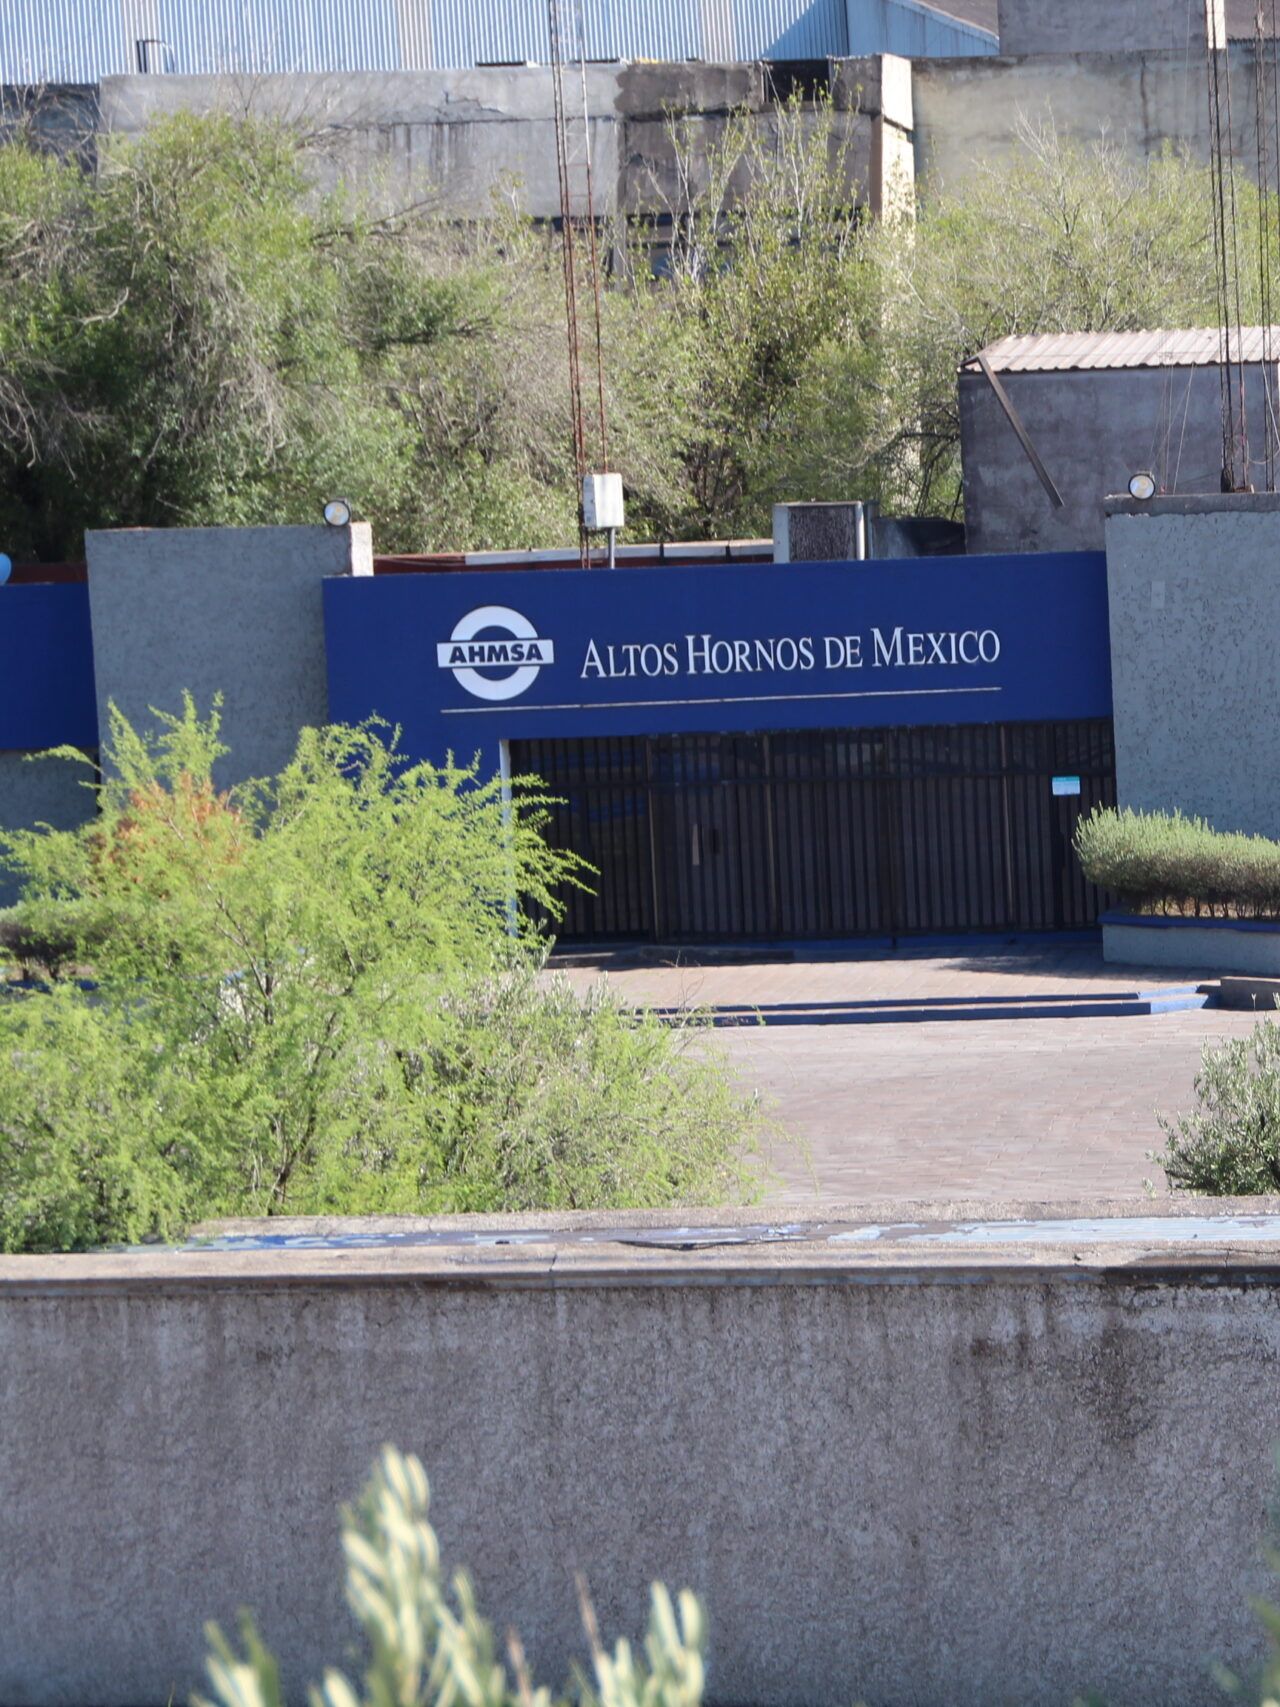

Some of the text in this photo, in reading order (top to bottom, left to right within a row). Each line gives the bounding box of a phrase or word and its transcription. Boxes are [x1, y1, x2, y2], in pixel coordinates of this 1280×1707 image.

[448, 642, 544, 664] AHMSA
[580, 626, 1001, 678] ALTOS HORNOS DE MEXICO
